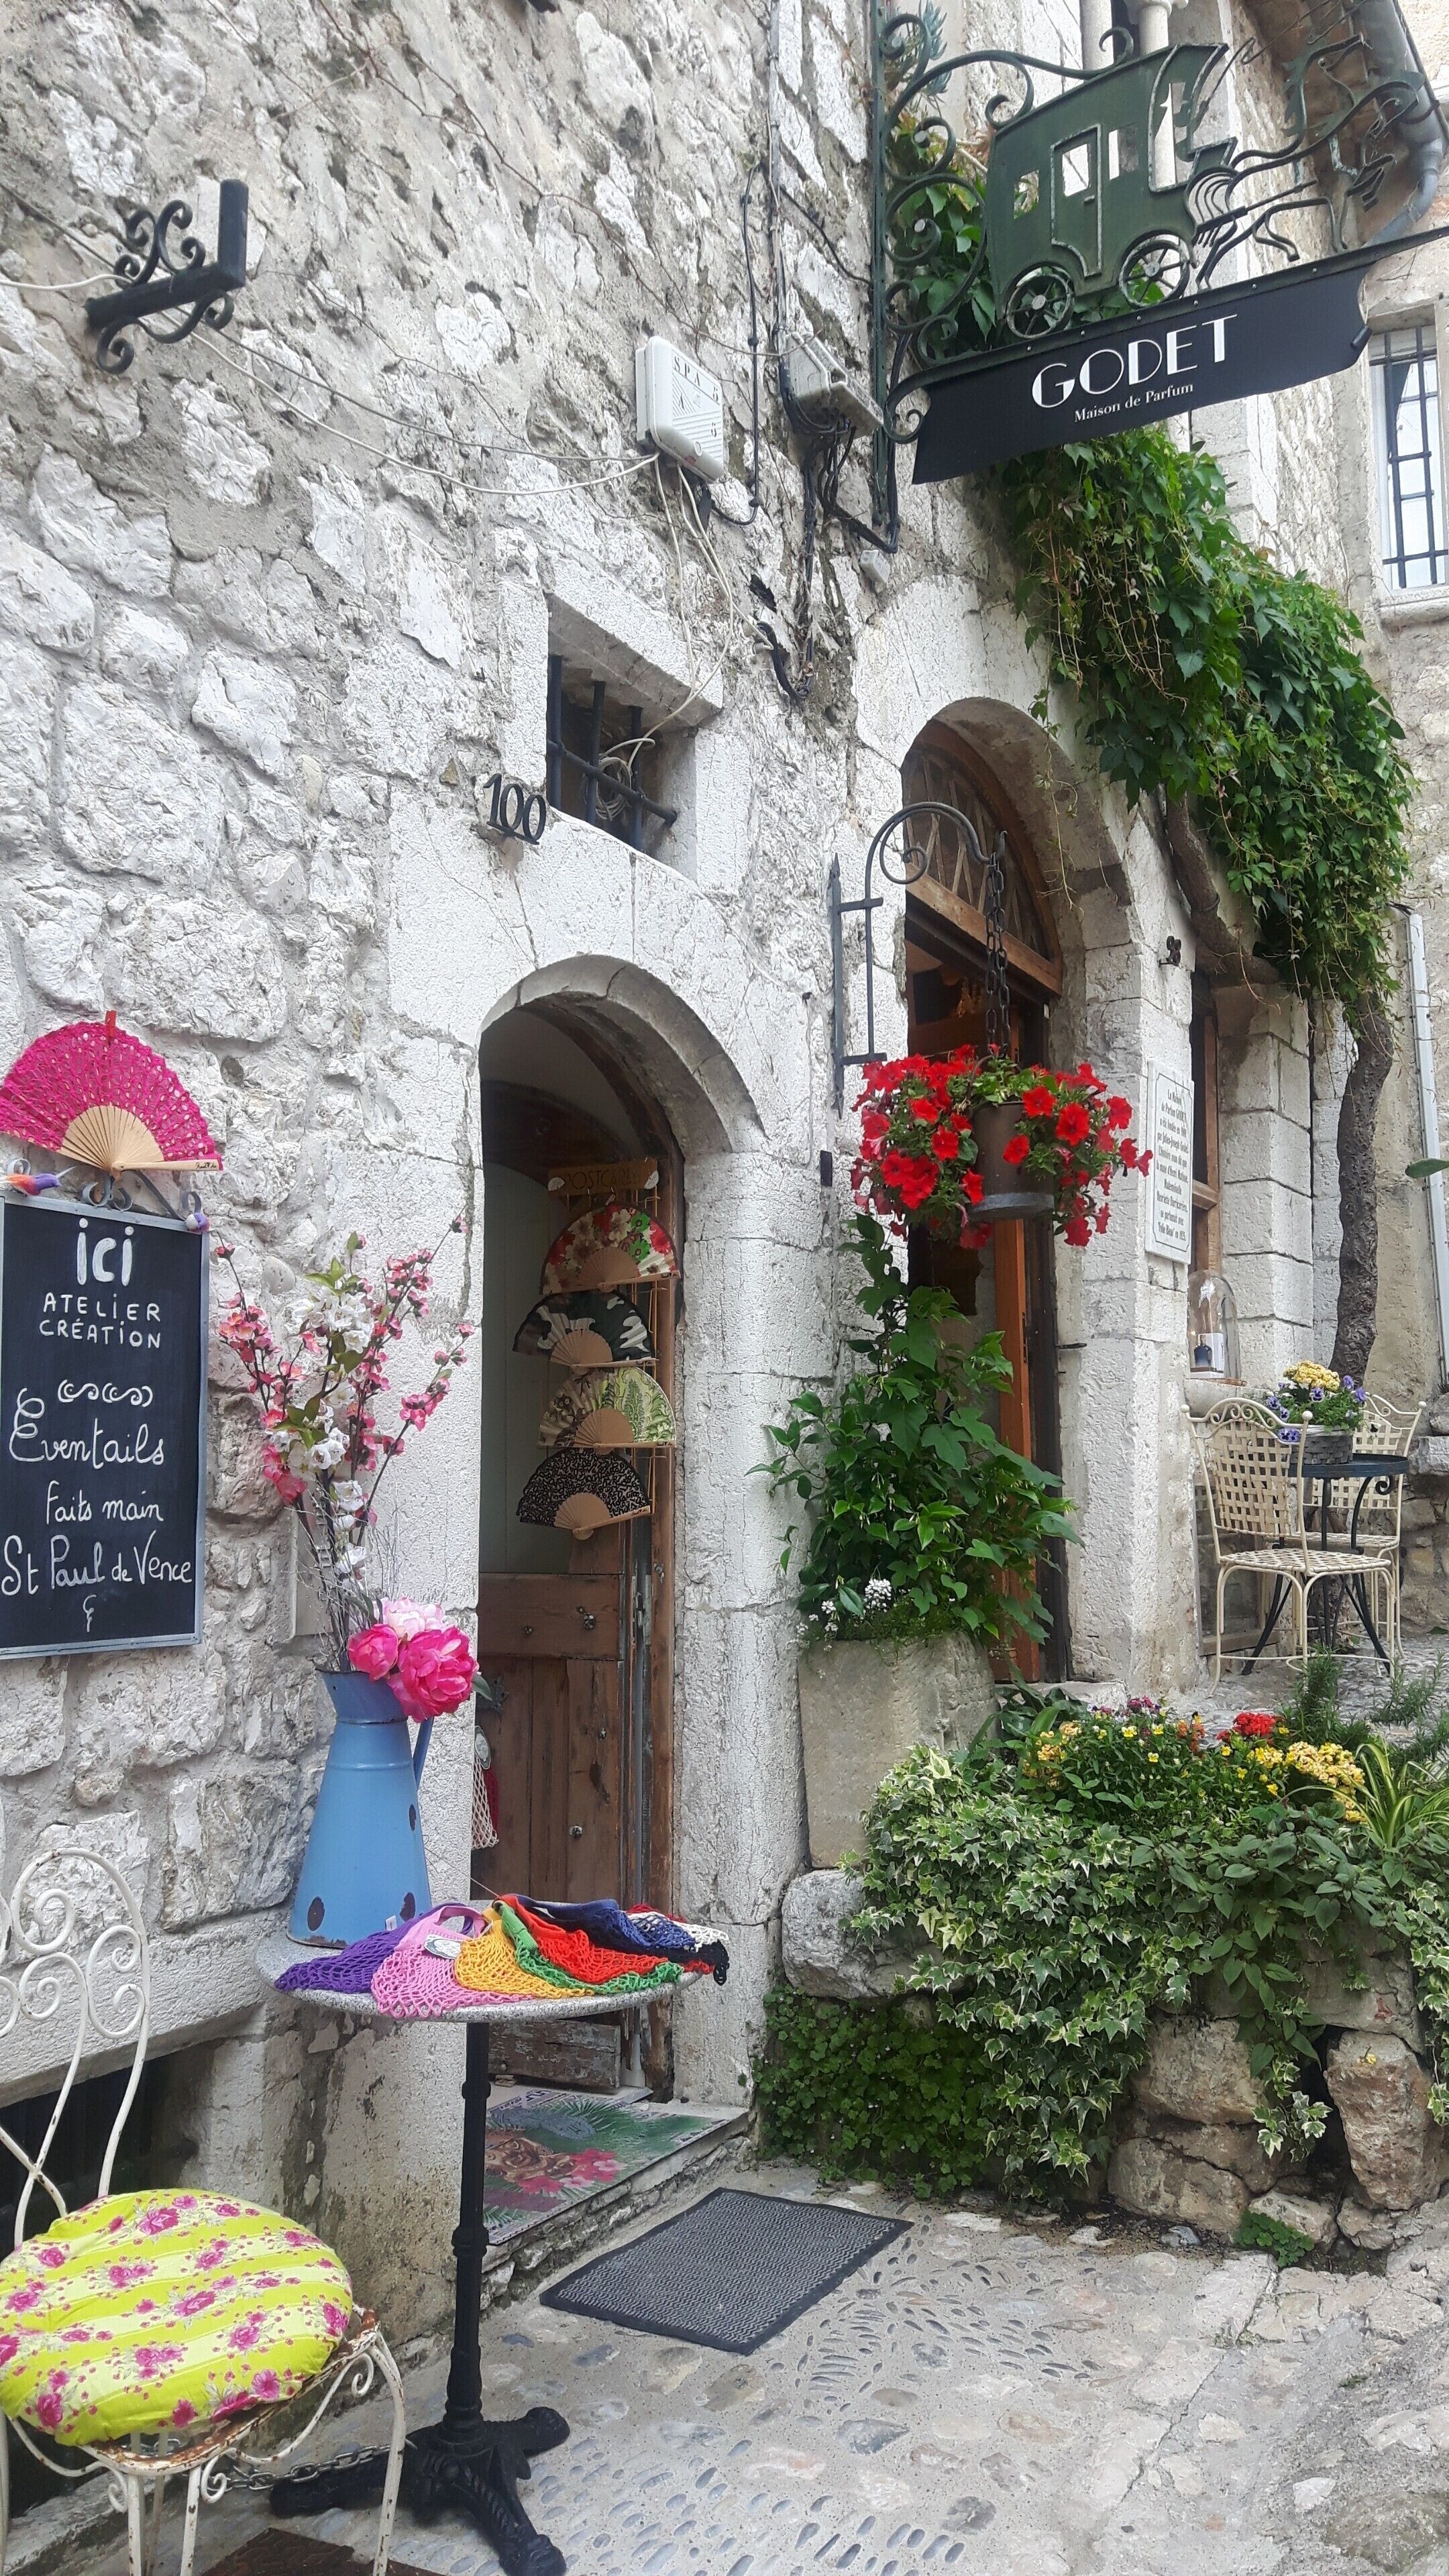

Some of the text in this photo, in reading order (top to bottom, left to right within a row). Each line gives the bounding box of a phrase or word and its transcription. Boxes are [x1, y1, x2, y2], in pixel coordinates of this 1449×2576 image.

[1032, 313, 1238, 409] GODET
[1074, 384, 1194, 423] Maison de Parfum
[483, 773, 547, 841] 100
[76, 1218, 134, 1287] ici
[9, 1387, 164, 1469] Eventails
[102, 1490, 164, 1522] main
[1, 1529, 193, 1596] St Paul de Vence
